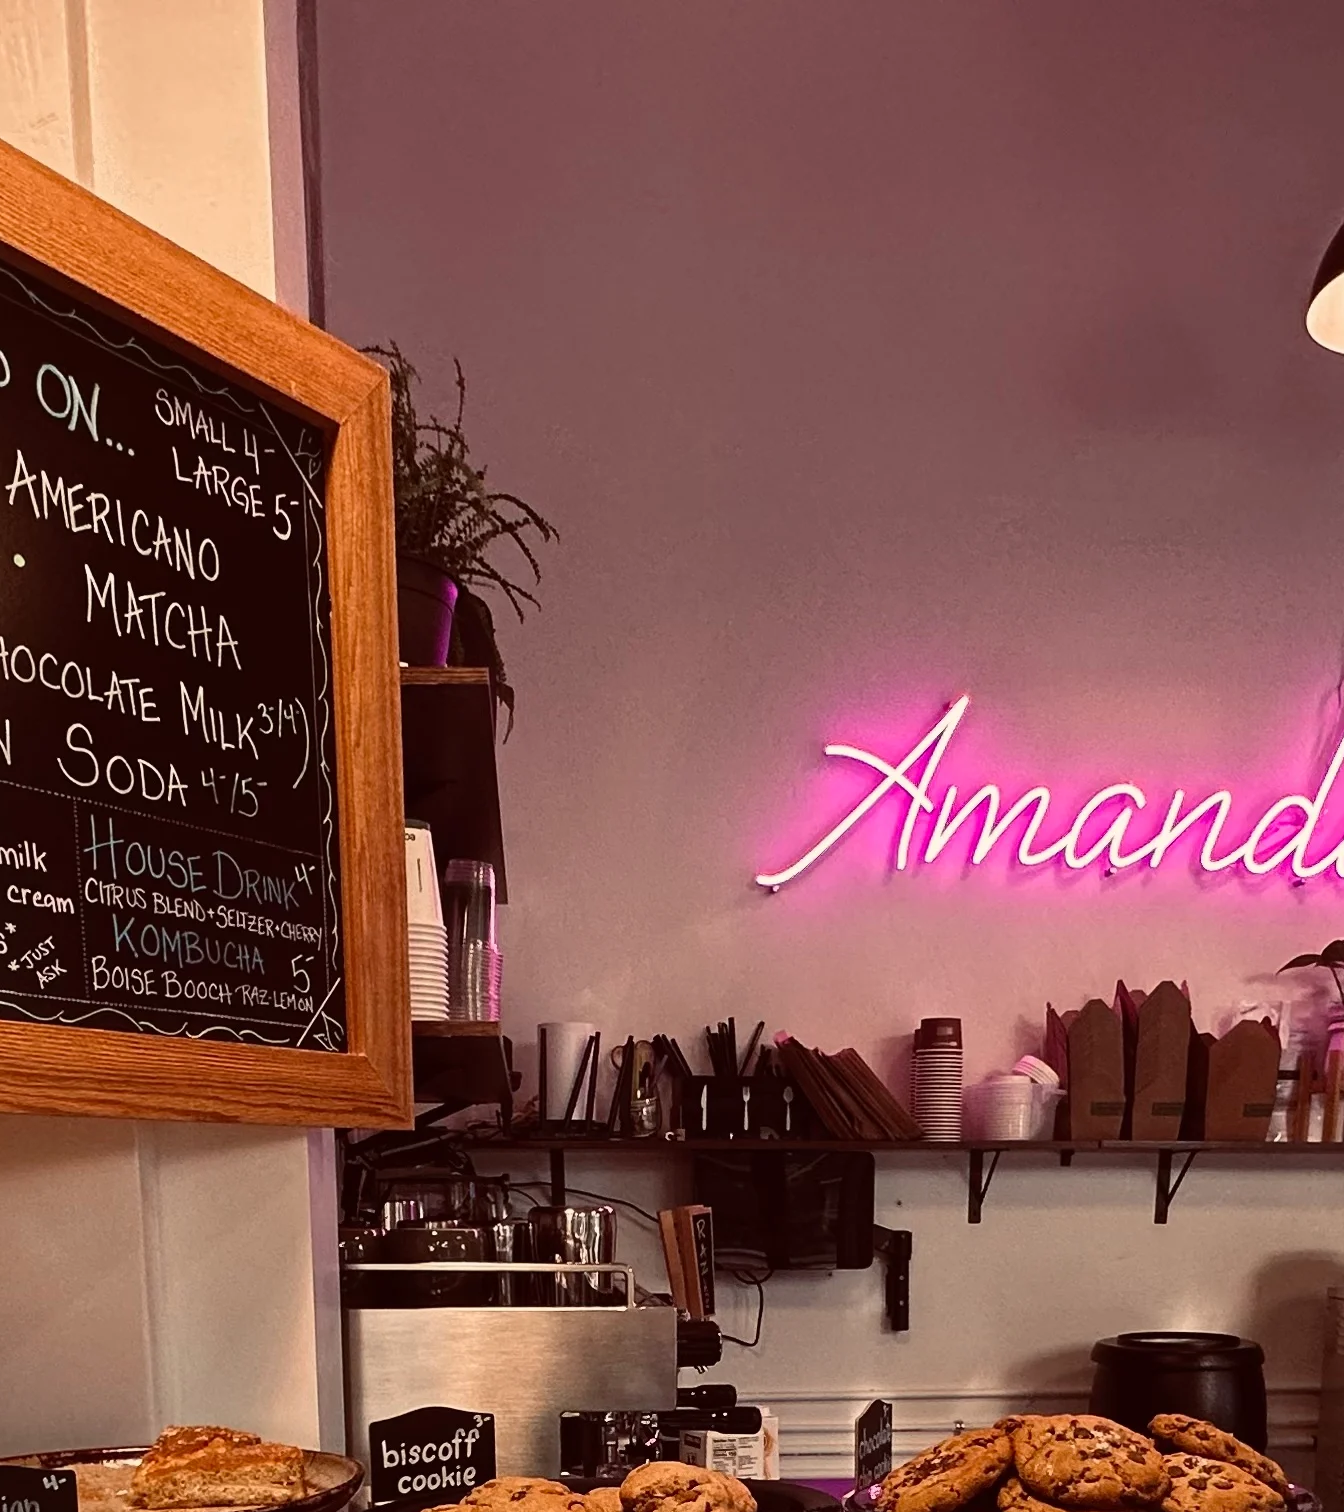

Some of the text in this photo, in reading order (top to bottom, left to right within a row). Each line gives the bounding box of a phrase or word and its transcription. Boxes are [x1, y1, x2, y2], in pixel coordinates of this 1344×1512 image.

[155, 389, 236, 454] SMALL
[172, 447, 265, 519] LARGE
[6, 450, 221, 582] AMERICANO
[85, 564, 243, 671] MATCHA
[180, 681, 259, 760] MILK
[57, 723, 189, 807] SODA
[83, 814, 206, 893] HOUSE
[213, 850, 300, 910] DRINK
[85, 877, 147, 909] CITRUS
[7, 884, 76, 915] cream
[35, 959, 68, 989] ASK
[112, 913, 265, 975] KOMBUCHA
[91, 955, 157, 996] BOISE
[161, 970, 233, 1006] BOOCH
[381, 1428, 480, 1469] biscoff
[397, 1465, 477, 1494] cookie
